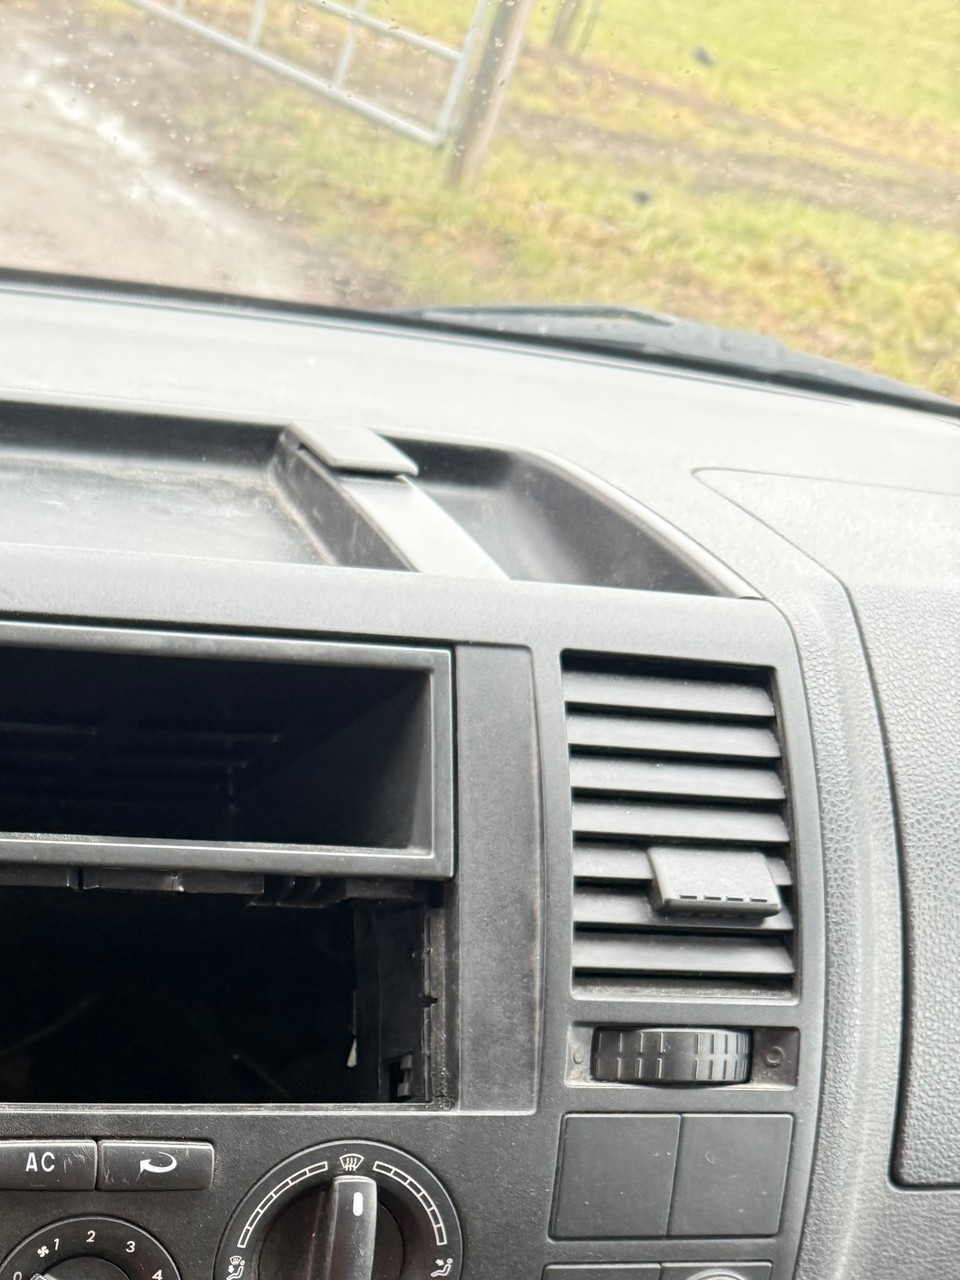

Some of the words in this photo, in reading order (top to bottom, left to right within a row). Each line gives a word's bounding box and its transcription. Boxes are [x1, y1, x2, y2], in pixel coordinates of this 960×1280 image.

[25, 1152, 55, 1173] AC
[53, 1238, 60, 1251] 1
[86, 1230, 96, 1243] 2
[125, 1240, 136, 1253] 3
